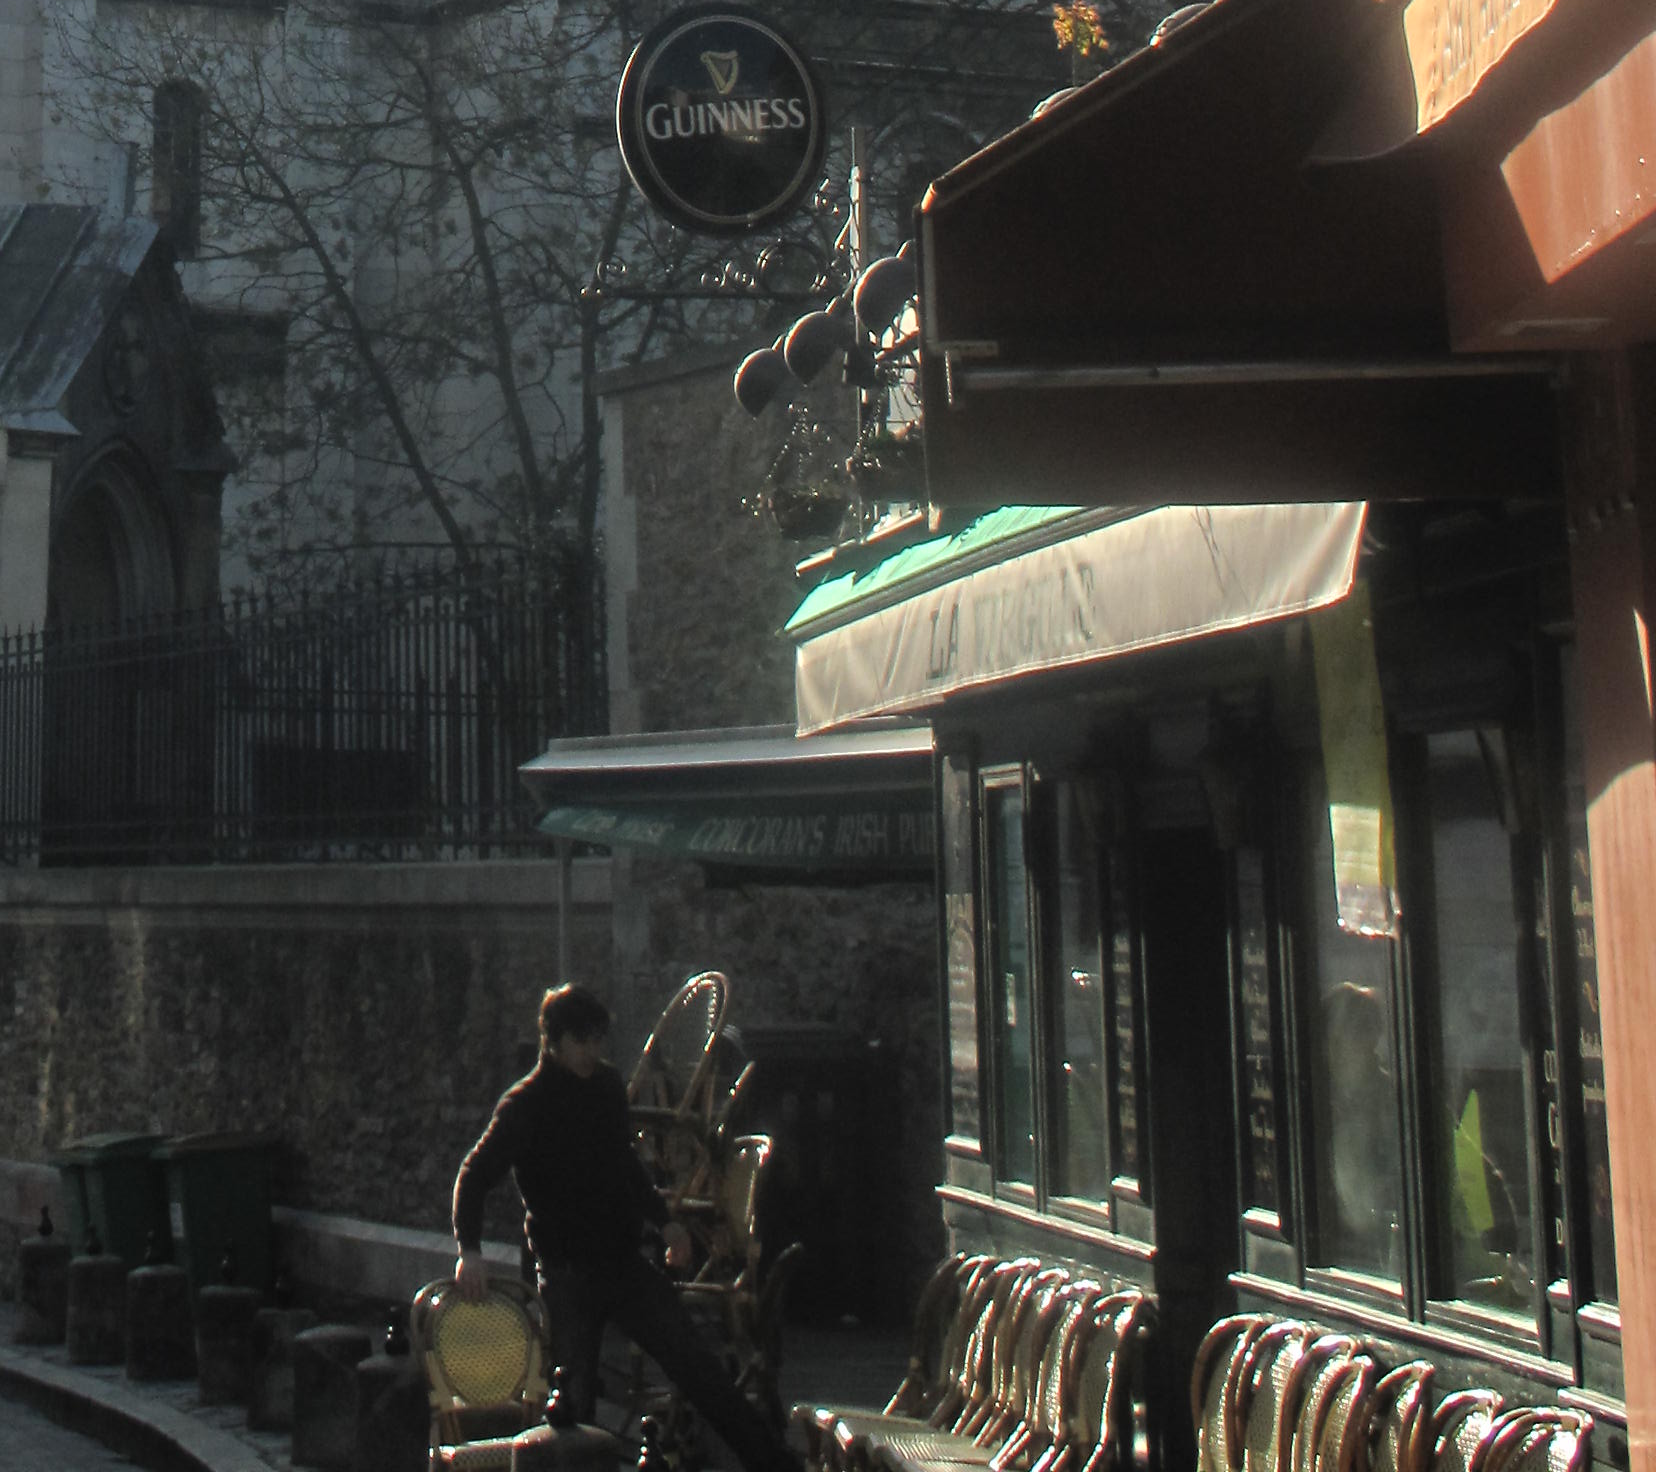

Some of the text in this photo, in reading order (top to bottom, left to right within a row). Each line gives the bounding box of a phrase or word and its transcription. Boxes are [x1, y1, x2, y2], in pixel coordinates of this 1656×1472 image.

[645, 98, 805, 140] GUINNESS
[926, 602, 960, 680] LA
[833, 813, 889, 857] IRISH
